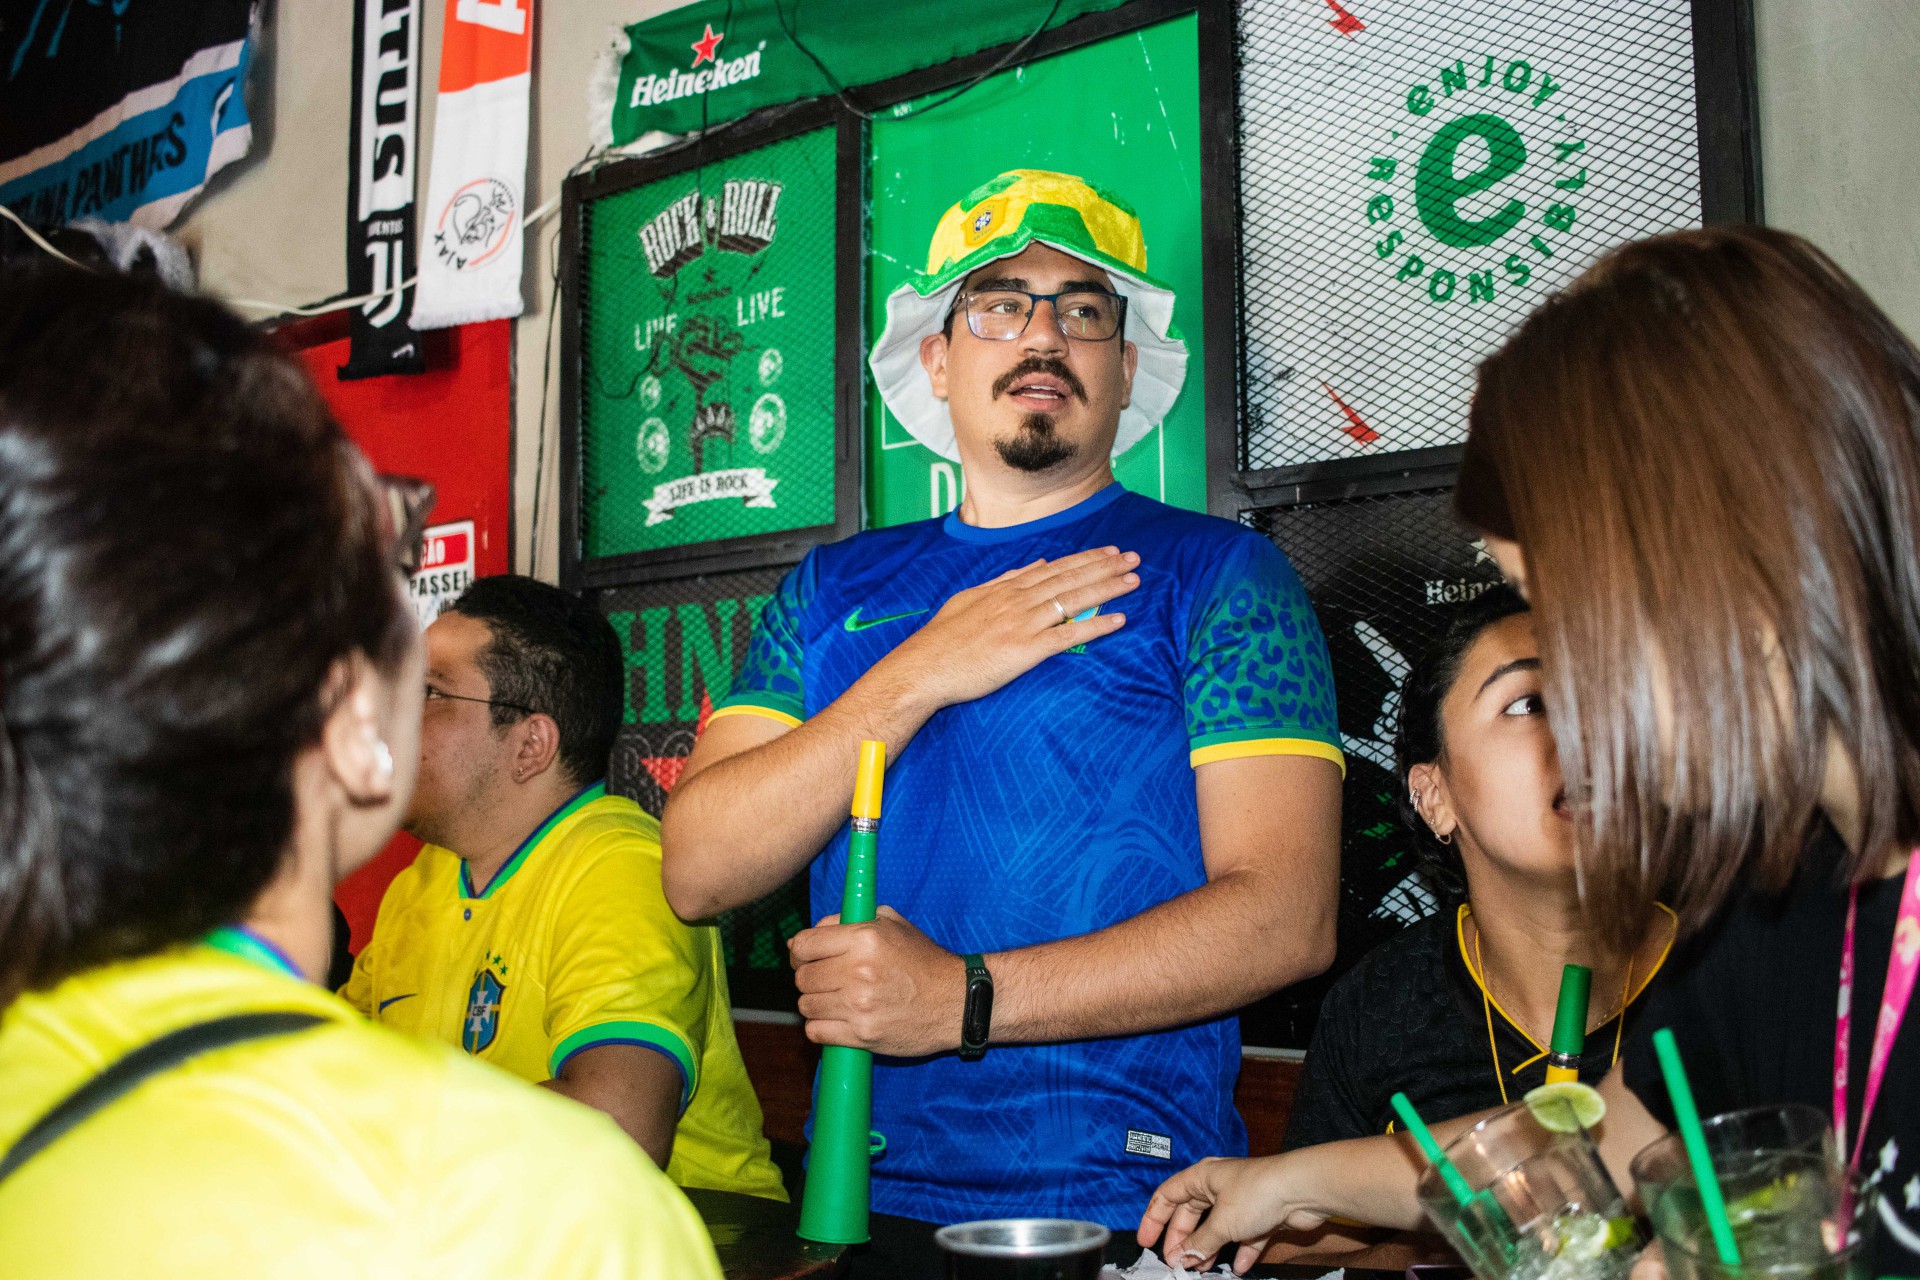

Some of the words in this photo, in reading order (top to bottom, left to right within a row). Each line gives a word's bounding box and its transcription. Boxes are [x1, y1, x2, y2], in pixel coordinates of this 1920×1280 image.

[629, 50, 762, 109] Heineken
[367, 218, 404, 239] ENTUS
[638, 191, 701, 275] ROCK
[720, 180, 783, 242] ROLL
[737, 286, 785, 327] LIVE
[715, 473, 749, 492] ROCK
[472, 1005, 487, 1017] CBF
